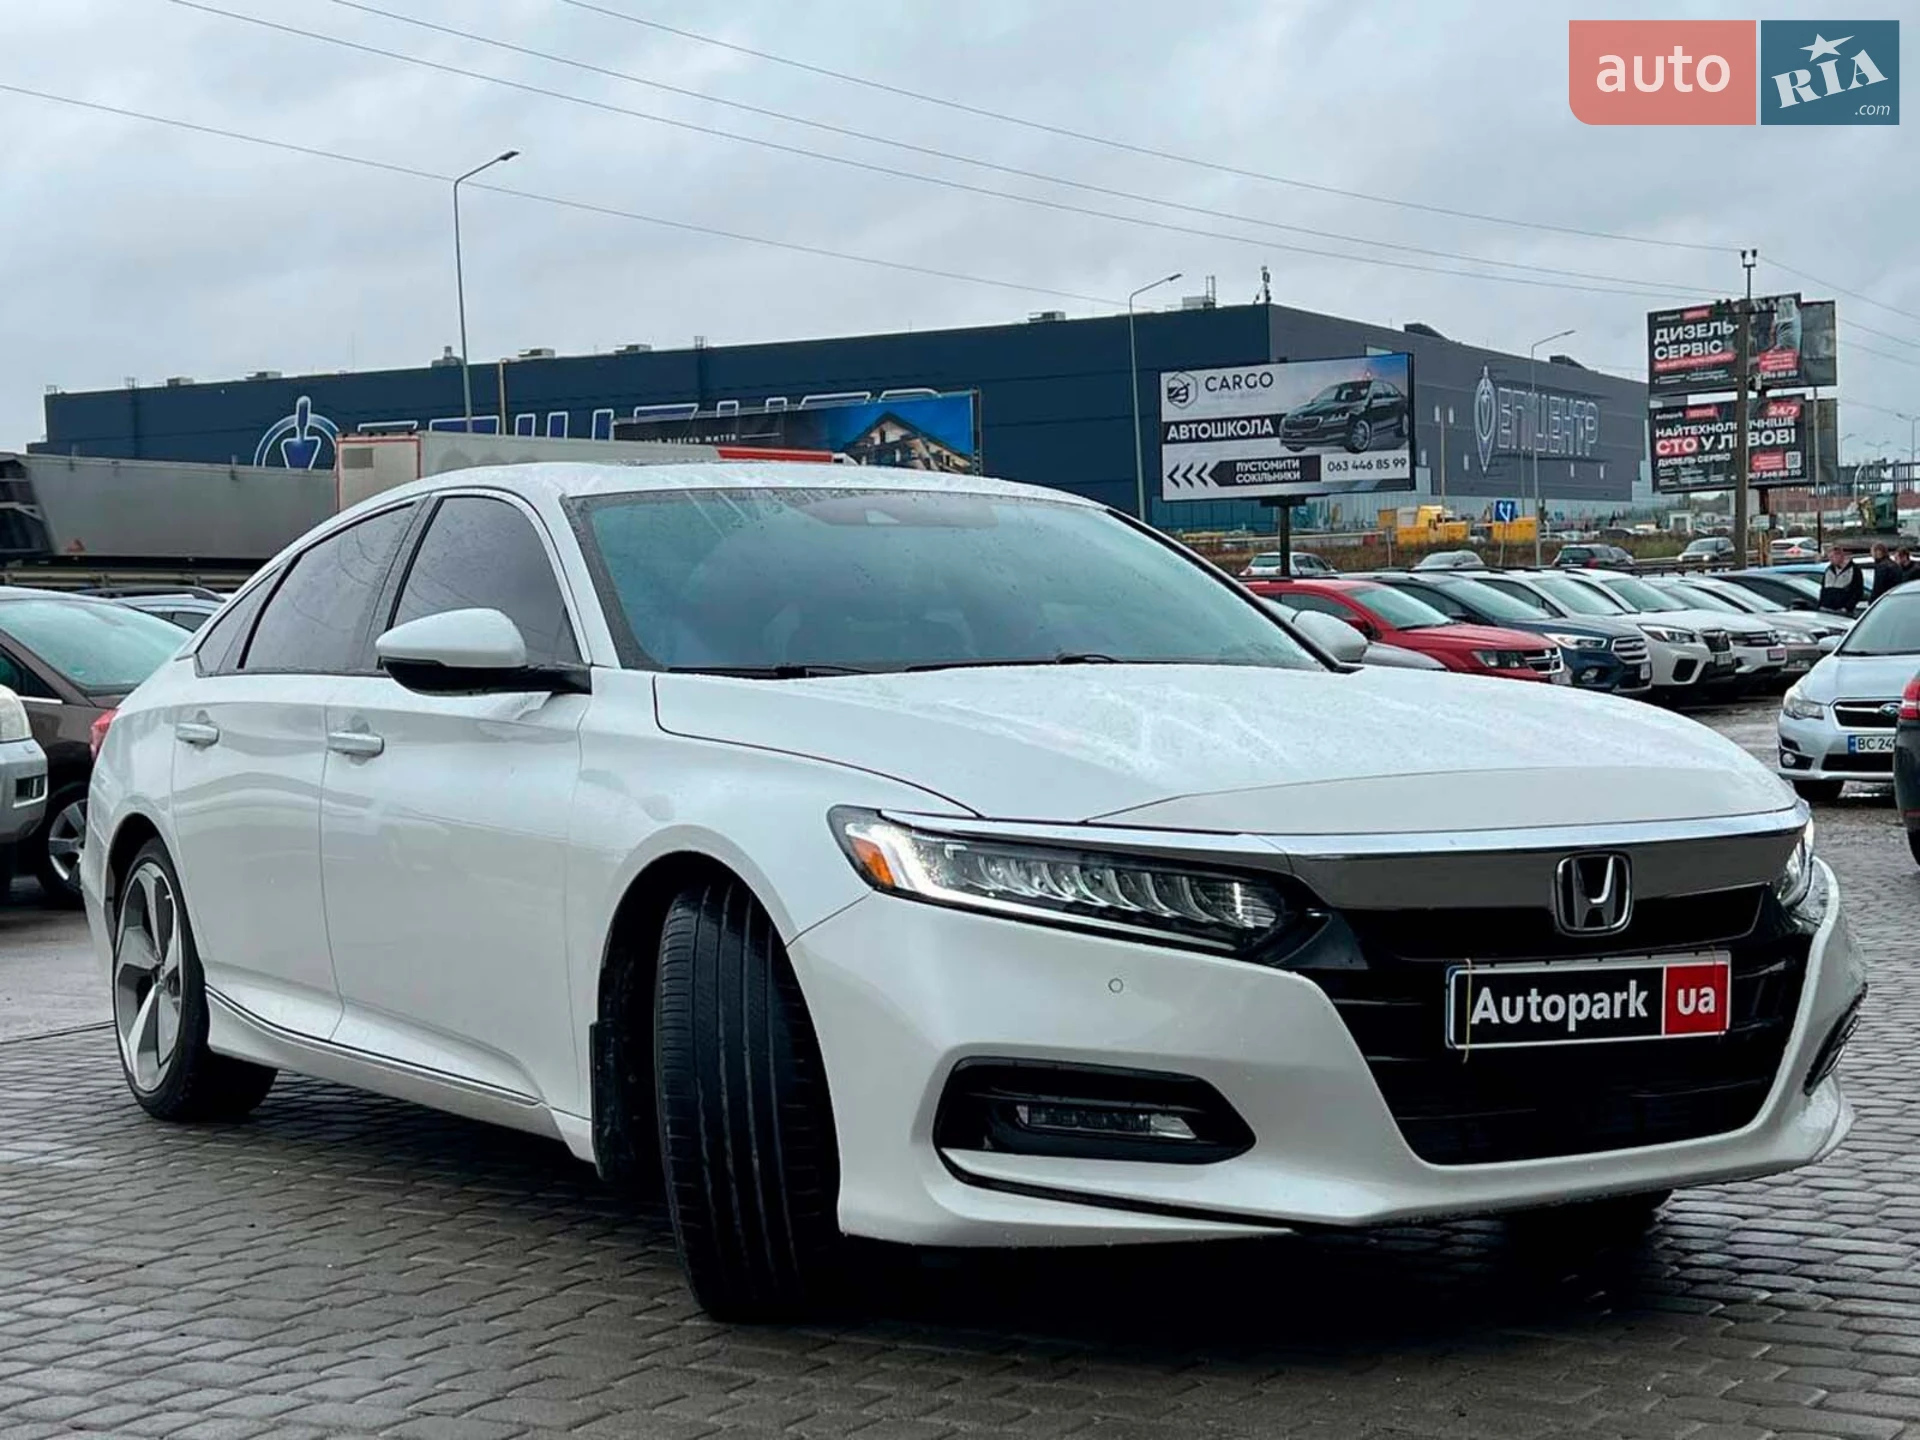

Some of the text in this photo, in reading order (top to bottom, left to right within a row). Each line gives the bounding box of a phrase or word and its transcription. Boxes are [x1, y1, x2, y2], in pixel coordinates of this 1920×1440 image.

[1654, 340, 1723, 360] СЕРВІС
[1205, 371, 1274, 392] CARGO
[1167, 418, 1274, 441] АВТОШКОЛА
[1656, 436, 1697, 456] СТО
[1700, 436, 1715, 451] У
[1236, 459, 1300, 472] ПУСТОМИТИ
[1327, 458, 1407, 472] 063 446 85 99
[1236, 471, 1301, 483] СОКІЛЬНИКИ
[1858, 738, 1875, 750] BC
[1470, 980, 1716, 1032] Autopark ua
